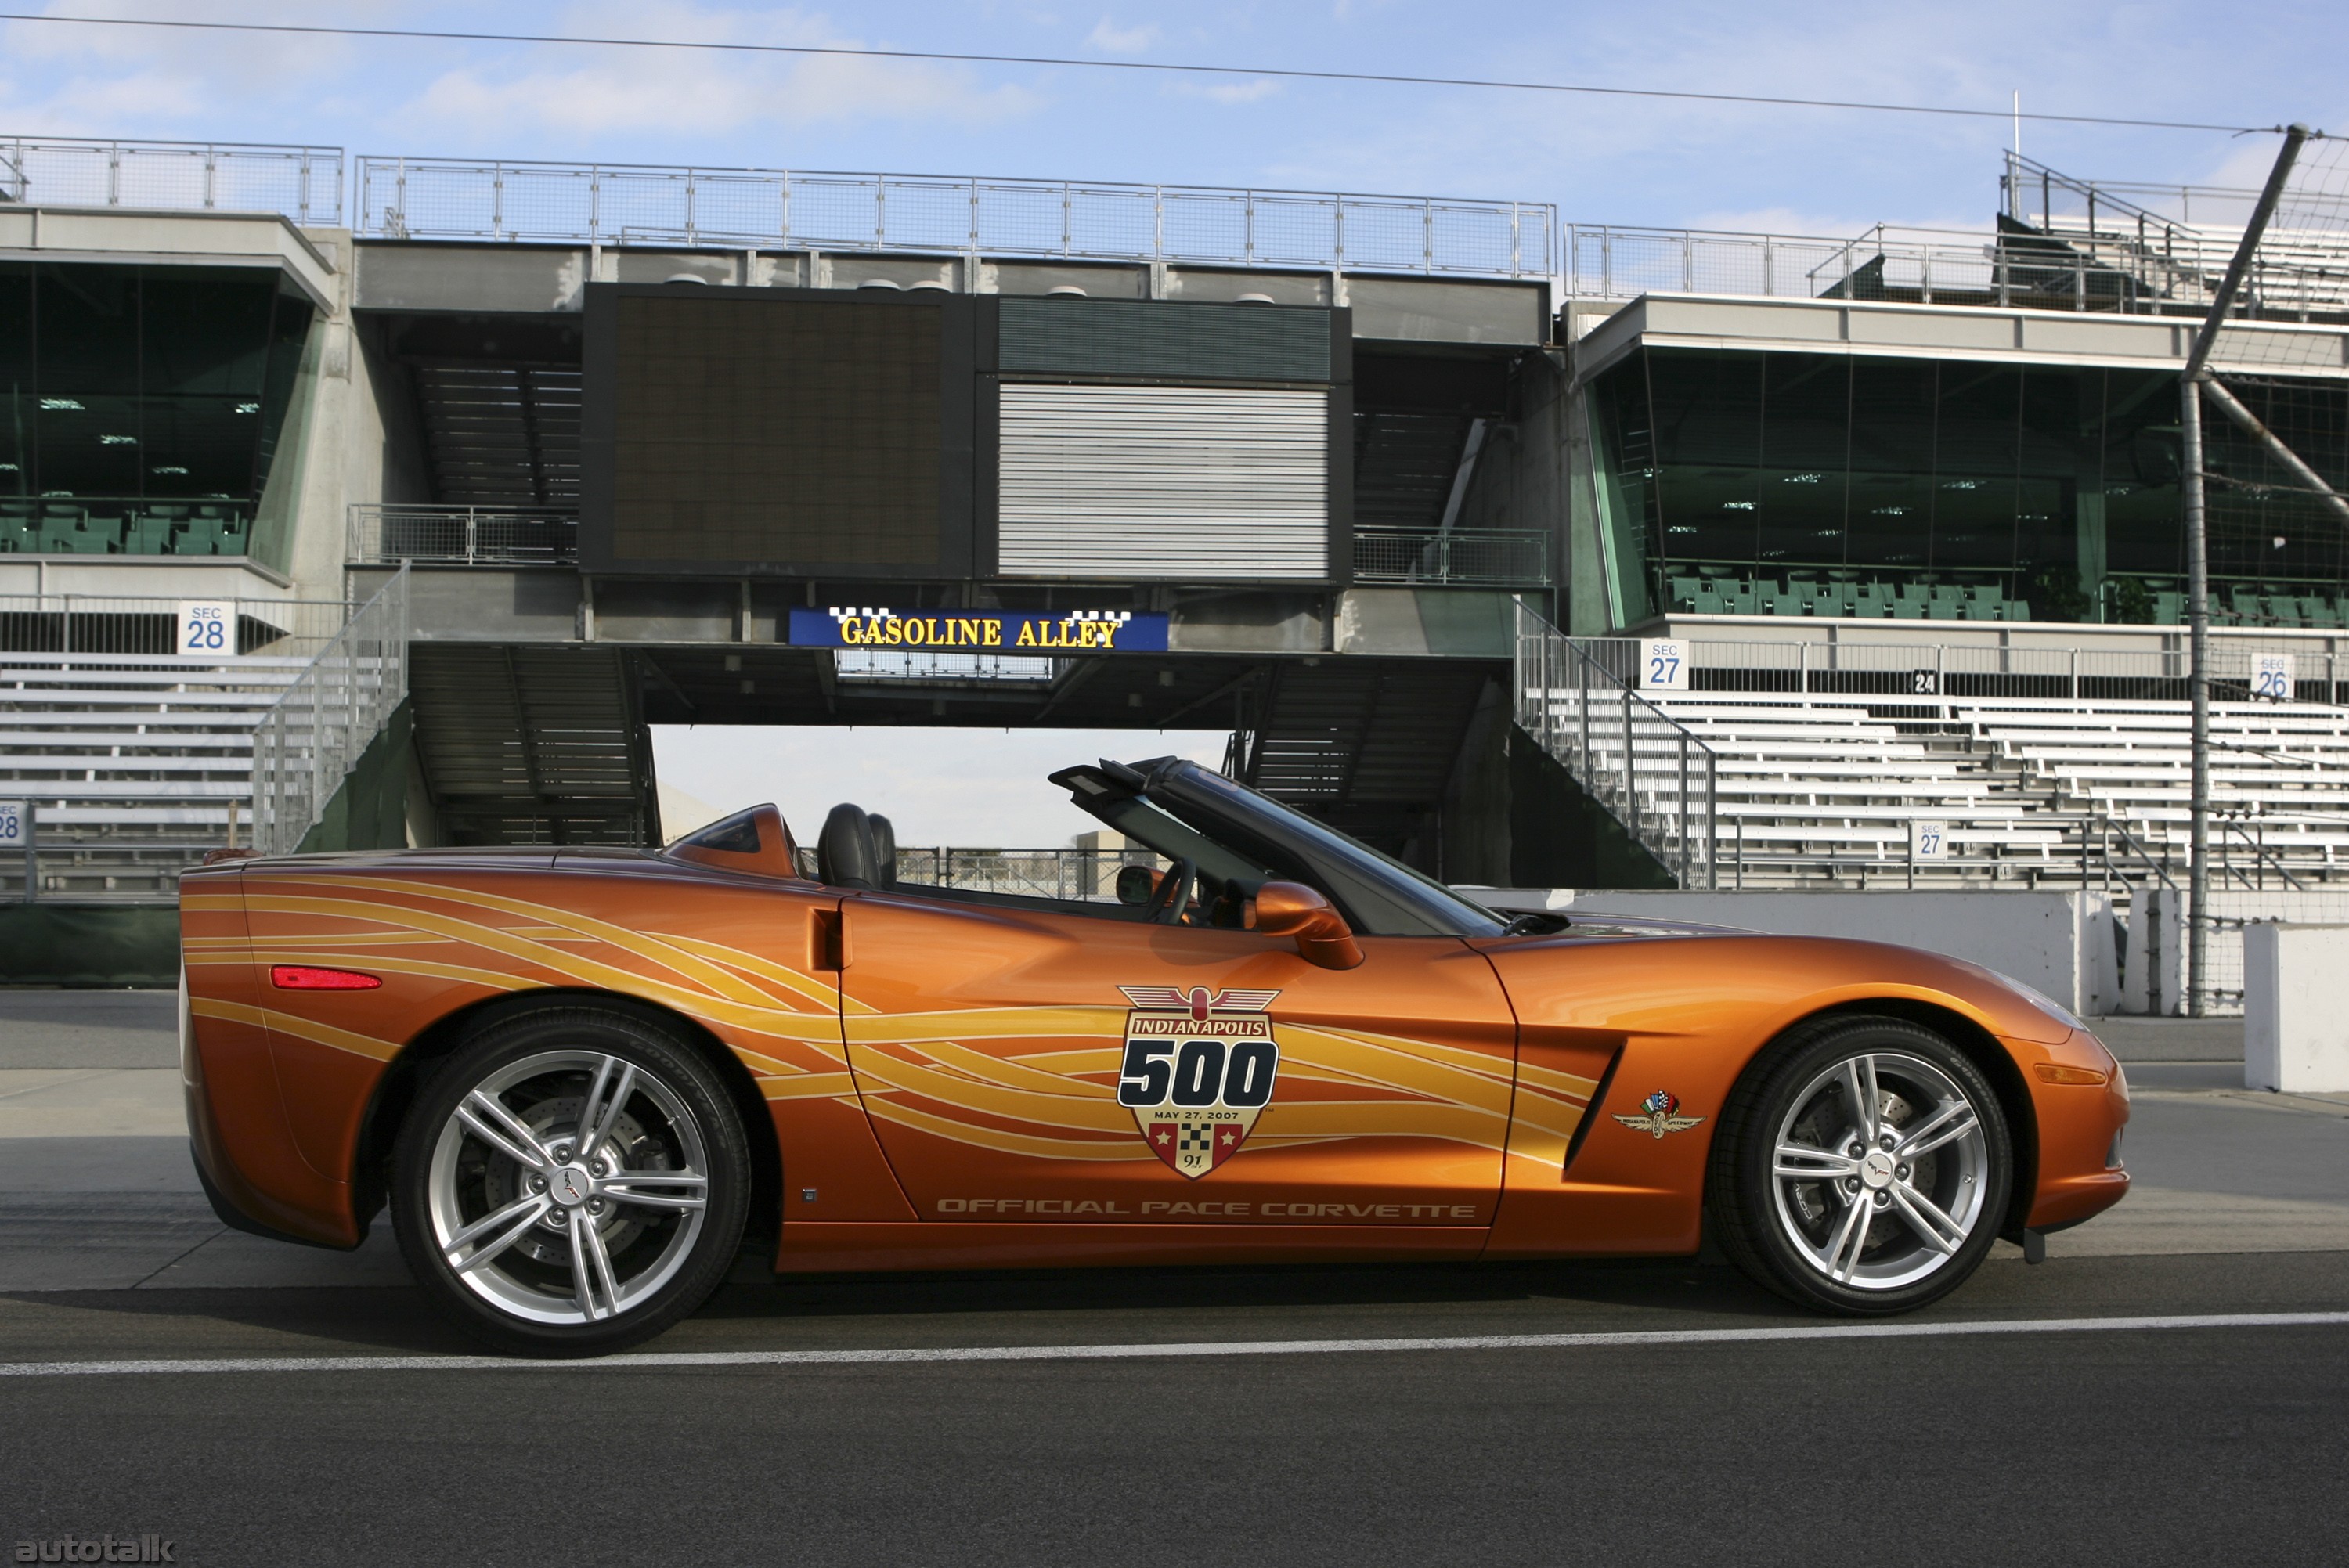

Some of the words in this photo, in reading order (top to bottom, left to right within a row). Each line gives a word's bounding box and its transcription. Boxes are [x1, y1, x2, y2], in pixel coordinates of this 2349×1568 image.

[192, 607, 222, 619] SEC
[187, 621, 224, 649] 28
[841, 617, 1001, 647] GASOLINE
[1016, 619, 1120, 649] ALLEY
[1652, 644, 1677, 656] SEC
[1650, 658, 1680, 683] 27
[2261, 659, 2284, 669] SEC
[1915, 674, 1935, 693] 24
[2260, 671, 2286, 697] 26
[1921, 825, 1939, 834] SEC
[1921, 834, 1940, 855] 27
[1135, 1019, 1265, 1036] INDIANAPOLIS
[1118, 1039, 1279, 1108] 500
[1185, 1112, 1203, 1120] 27,
[937, 1199, 1130, 1214] OFFICIAL
[1141, 1201, 1250, 1217] PACE
[1261, 1202, 1476, 1218] CORVETTE
